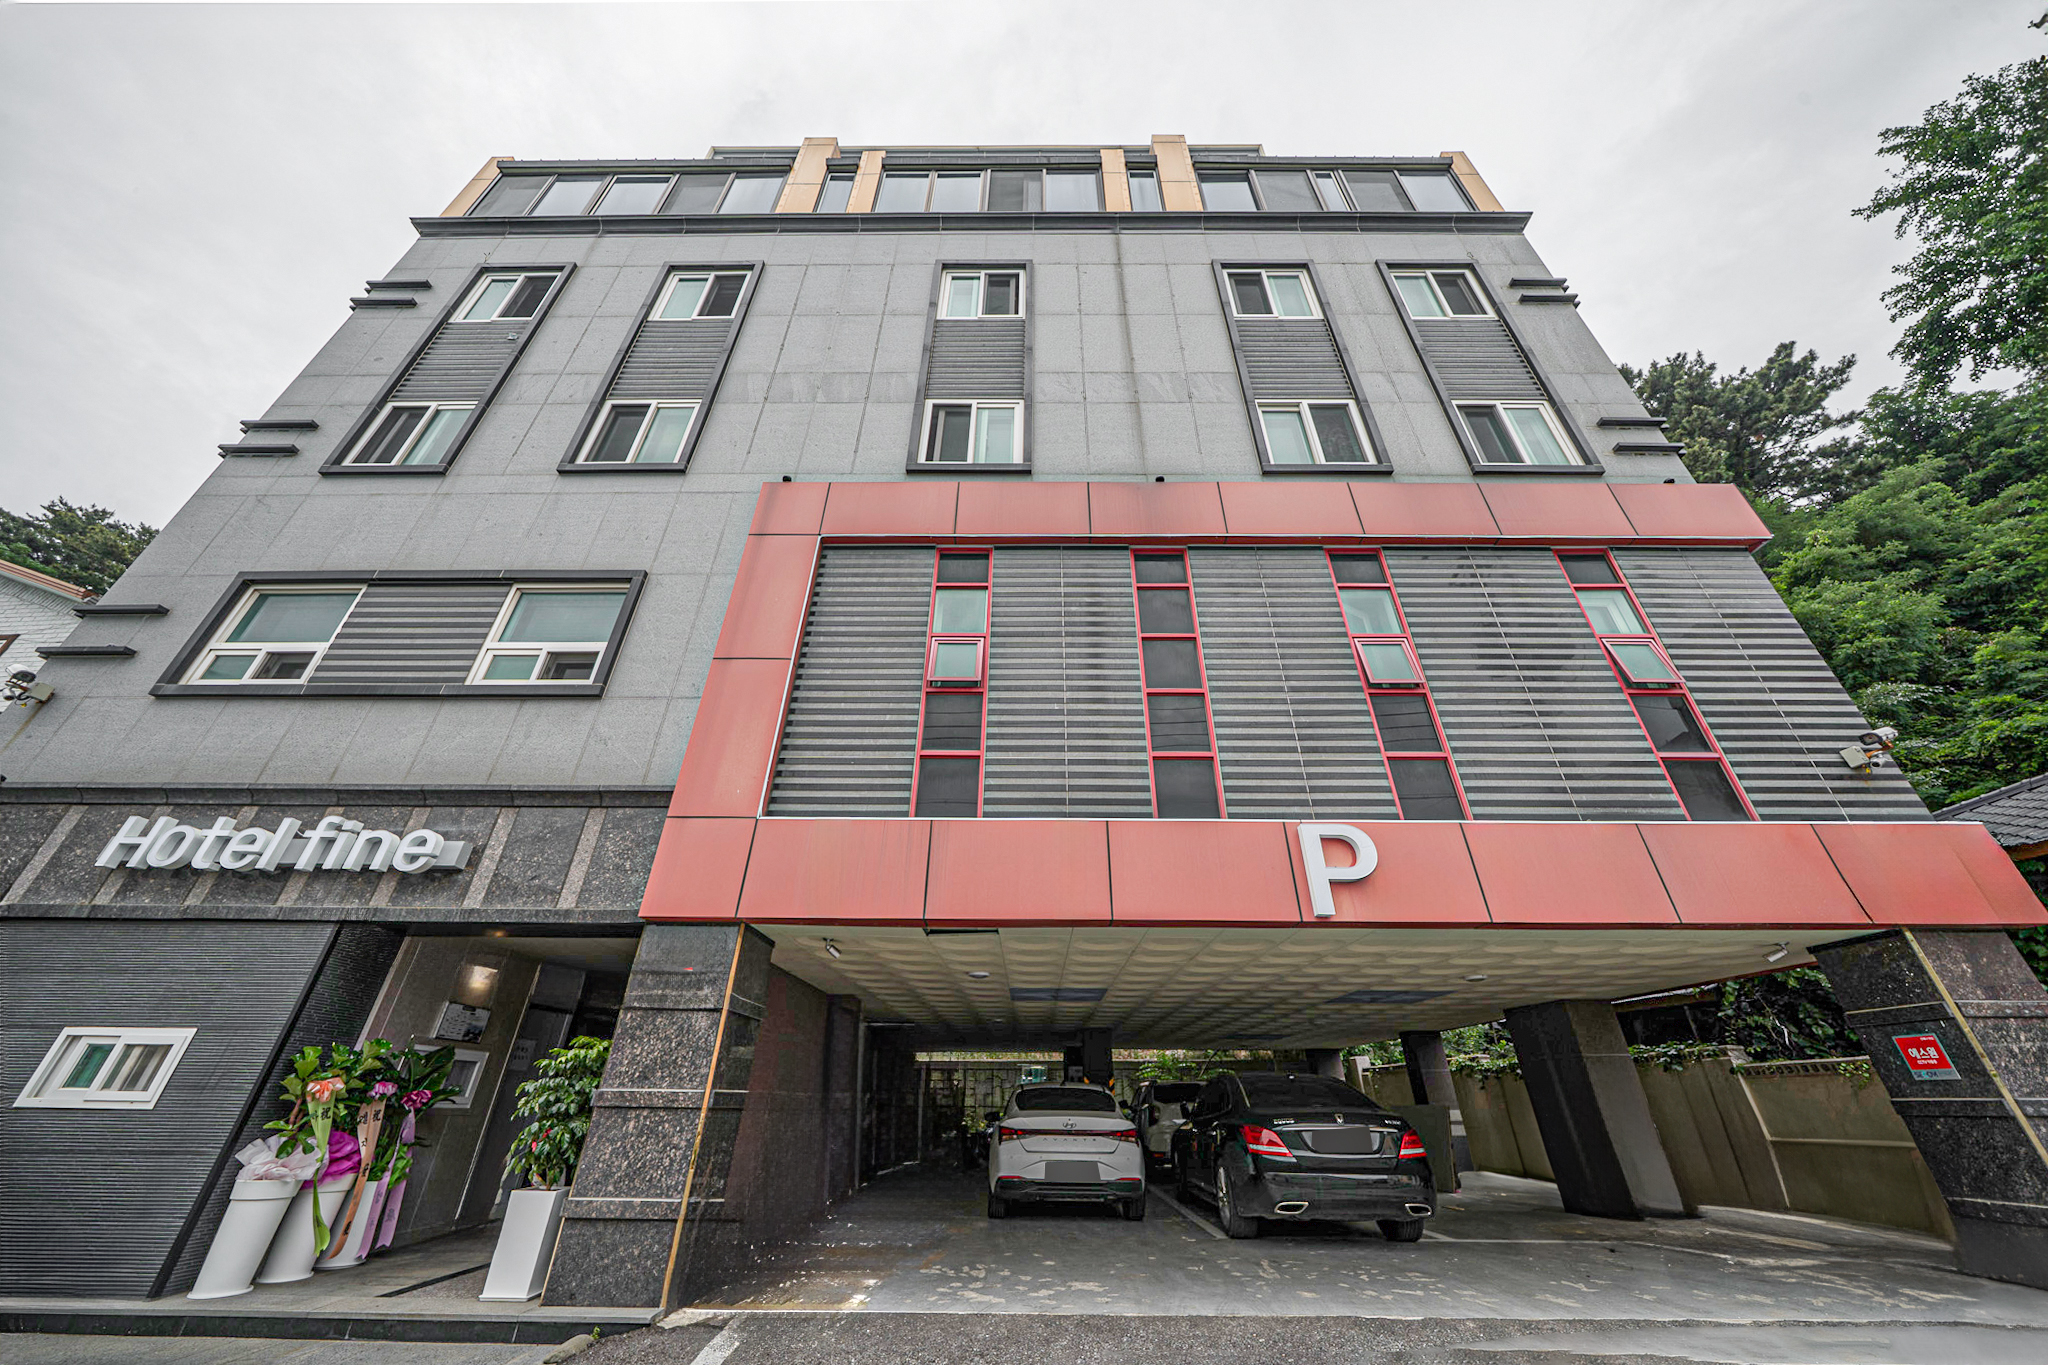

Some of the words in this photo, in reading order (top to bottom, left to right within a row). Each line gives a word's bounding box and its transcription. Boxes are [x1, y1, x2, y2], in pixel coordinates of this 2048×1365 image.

[95, 815, 301, 873] Hotel
[294, 815, 445, 874] fine
[1297, 823, 1378, 918] P
[1907, 1046, 1939, 1059] 에스원
